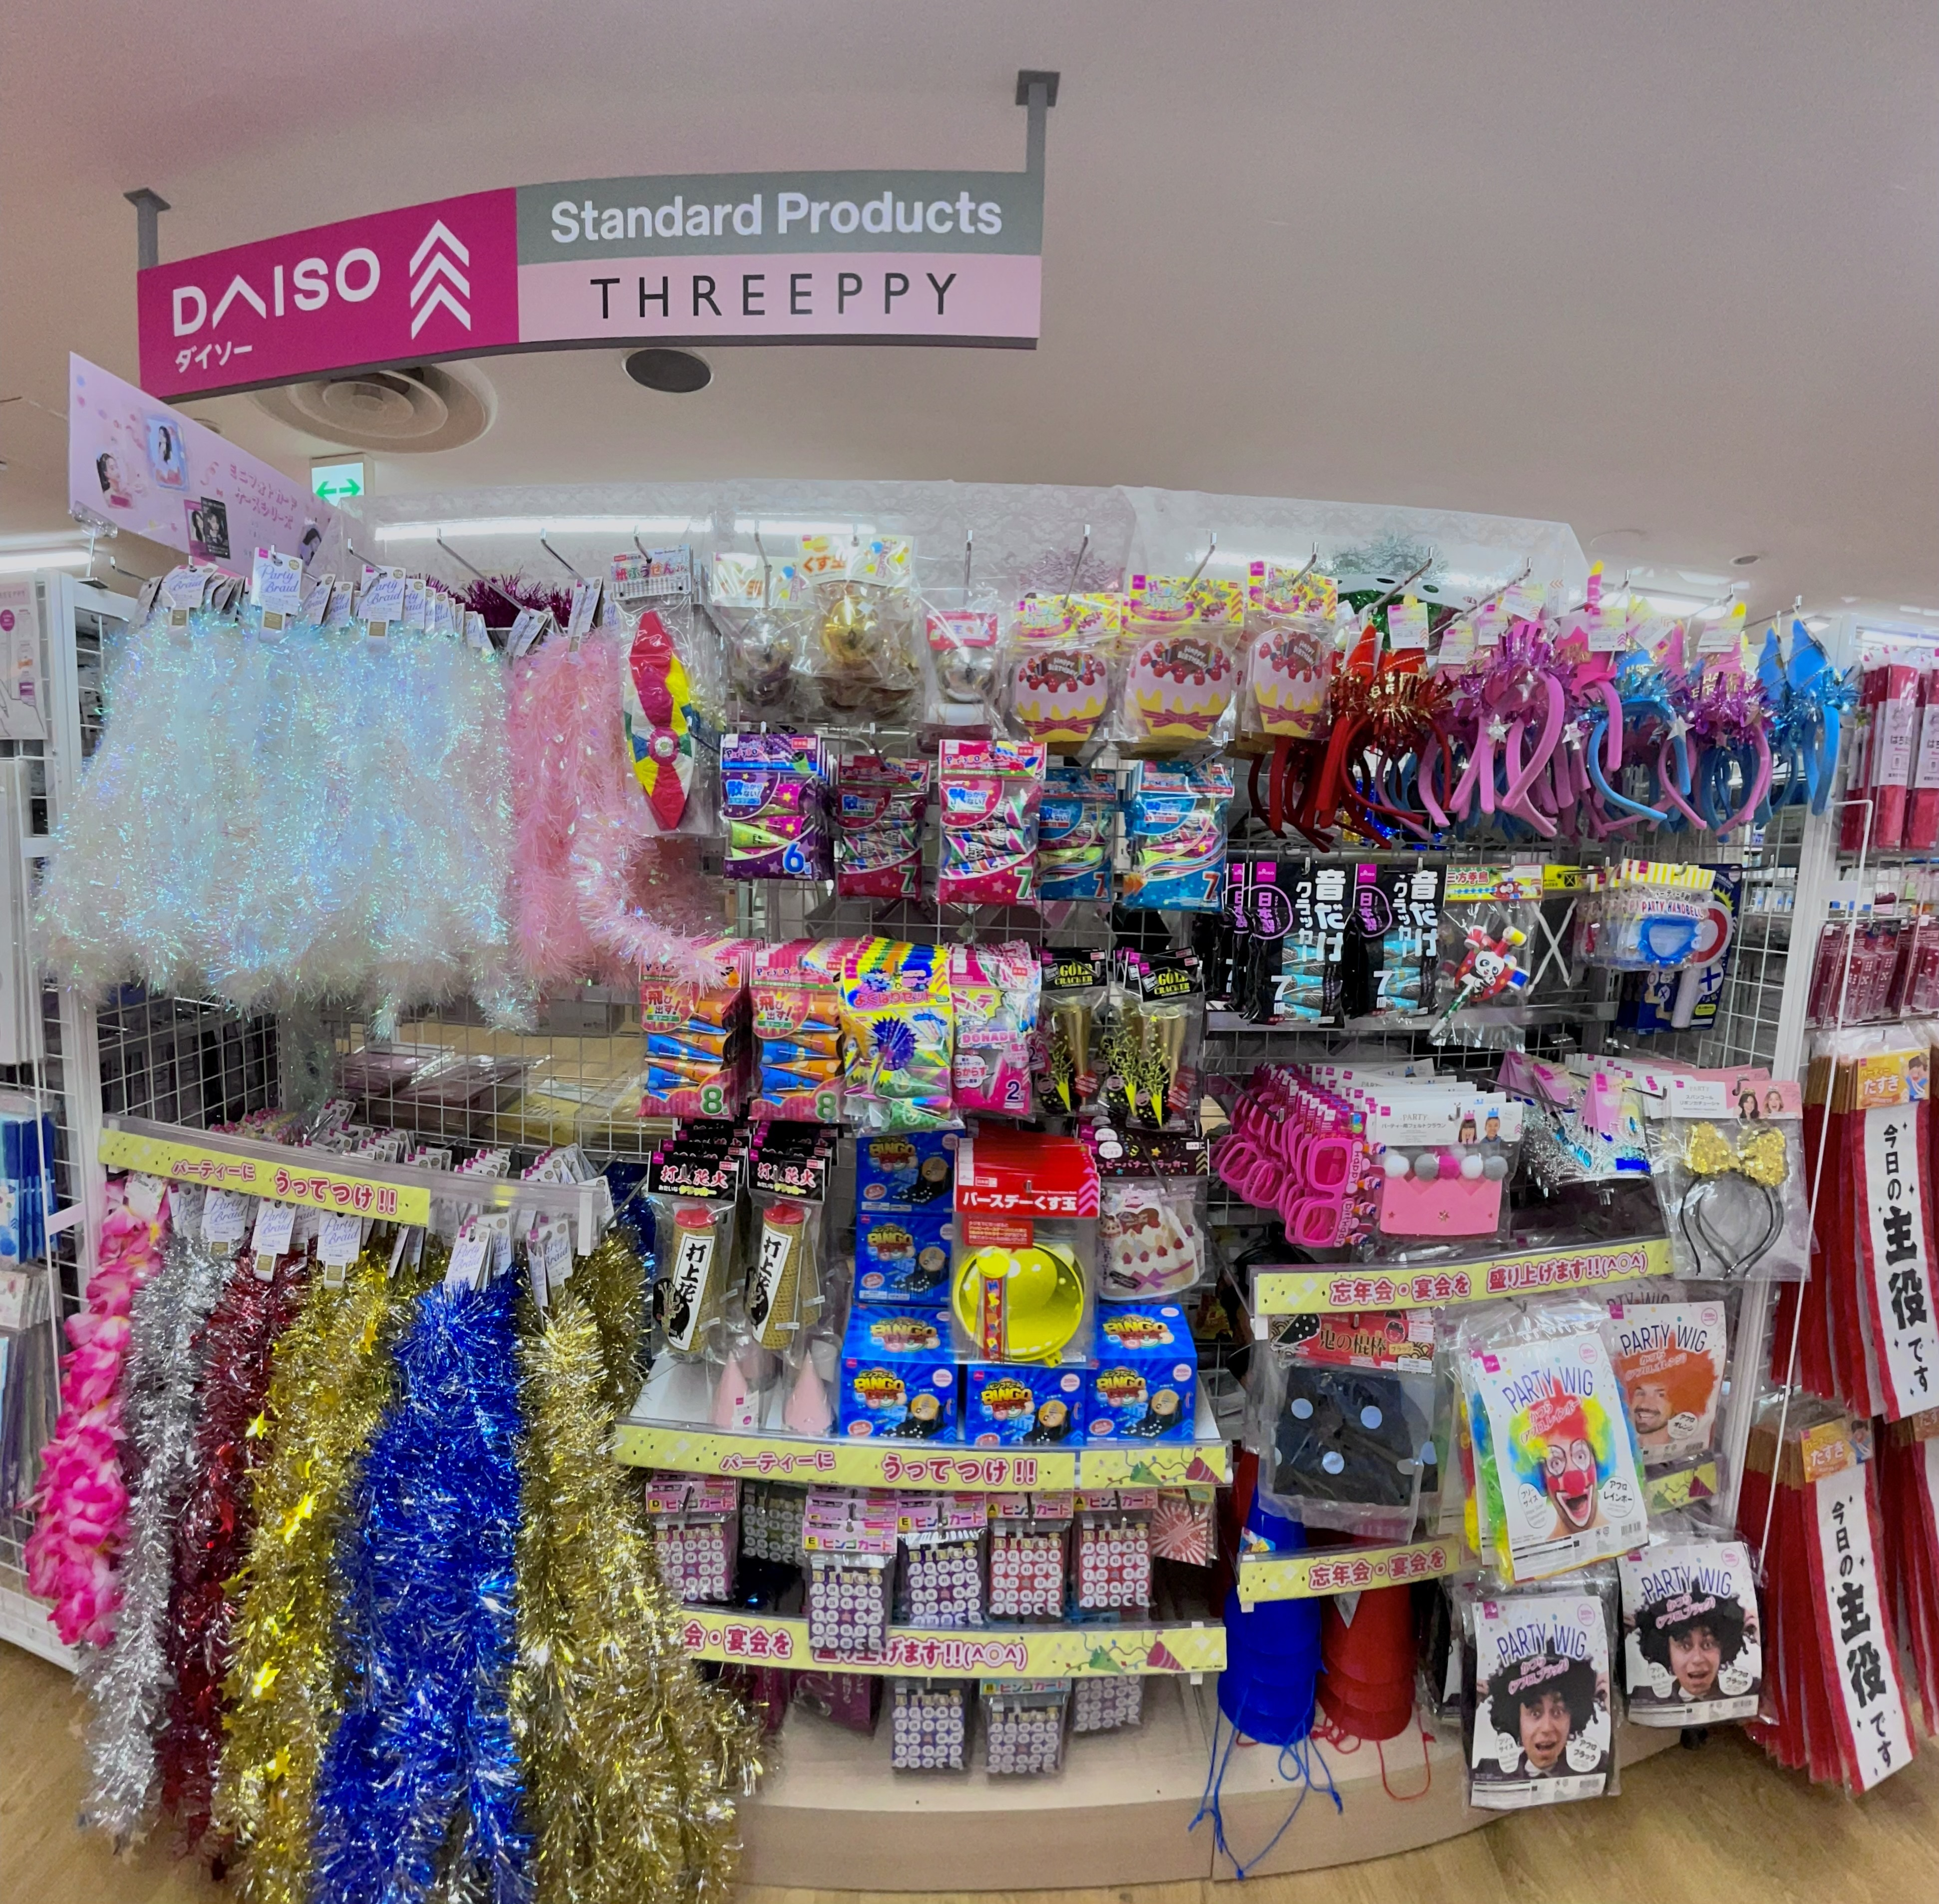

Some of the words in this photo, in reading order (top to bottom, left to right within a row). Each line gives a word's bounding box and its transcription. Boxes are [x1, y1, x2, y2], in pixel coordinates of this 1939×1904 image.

[551, 194, 762, 244] Standard
[777, 191, 1002, 236] Products
[173, 248, 380, 337] DAISO
[590, 273, 957, 319] THREEPPY
[175, 341, 253, 373] ダイソー
[260, 565, 295, 584] Party
[265, 580, 300, 593] Braid
[367, 590, 402, 607] Braid
[1177, 651, 1208, 669] BIRTHDAY
[1184, 645, 1206, 659] HAPPY
[1048, 664, 1077, 677] BIRTHDAY
[1053, 657, 1076, 669] HAPPY
[783, 842, 804, 874] 6
[899, 865, 917, 893] 7
[1014, 867, 1033, 899] 7
[1093, 872, 1105, 899] 7
[1202, 871, 1220, 901] 7
[1258, 892, 1276, 934] 日本製
[1314, 869, 1346, 962] 音だけ
[1359, 892, 1378, 933] 日本製
[1391, 882, 1408, 952] クラッカー
[1409, 870, 1439, 957] 音だけ
[1641, 899, 1664, 913] PARTY
[1667, 901, 1704, 918] HANDBELL
[1295, 881, 1312, 962] クラッカー
[1059, 963, 1093, 976] GOLD
[1158, 969, 1188, 986] GOLD
[1054, 975, 1093, 985] CRACKER
[1154, 982, 1190, 995] CRACKER
[1271, 975, 1292, 1001] 7
[1373, 970, 1392, 995] 7
[1006, 1080, 1019, 1100] 2
[1864, 1075, 1899, 1095] たすき
[701, 1085, 723, 1115] 8
[815, 1090, 838, 1120] 8
[869, 1141, 916, 1158] BINGO
[171, 1160, 257, 1182] パーティーに
[274, 1168, 399, 1215] うってつけ!!
[212, 1197, 244, 1215] Party
[963, 1192, 1077, 1211] バースデーくす玉
[209, 1208, 248, 1225] Braid
[262, 1208, 292, 1226] Party
[324, 1217, 358, 1236] Party
[260, 1221, 292, 1236] Braid
[324, 1231, 359, 1244] Braid
[867, 1230, 913, 1248] BINGO
[455, 1244, 480, 1257] Party
[1883, 1123, 1929, 1394] 今日の主役です
[454, 1255, 481, 1270] Braid
[1329, 1273, 1472, 1306] 忘年会・宴会を
[1103, 1320, 1168, 1335] BINGO
[1620, 1323, 1671, 1356] PARTY
[1676, 1324, 1708, 1352] WIG
[854, 1377, 906, 1393] BINGO
[1096, 1376, 1146, 1392] BINGO
[1502, 1367, 1554, 1413] PARTY
[1559, 1366, 1594, 1397] WIG
[980, 1387, 1033, 1404] BINGO
[1528, 1400, 1553, 1427] かつら
[1810, 1440, 1845, 1467] たすき
[719, 1449, 837, 1474] パーティーに
[881, 1453, 1039, 1486] うってつけ!!
[1520, 1487, 1535, 1499] フリー
[1603, 1490, 1633, 1502] レインボー
[1610, 1481, 1628, 1491] アフロ
[1523, 1496, 1538, 1507] サイズ
[1309, 1547, 1448, 1590] 忘年会・宴会を
[1641, 1566, 1692, 1603] PARTY
[1699, 1566, 1732, 1596] WIG
[682, 1620, 793, 1659] 会・宴会を
[1497, 1622, 1547, 1665] PARTY
[1554, 1623, 1587, 1658] WIG
[1831, 1500, 1892, 1768] 今日の主役です
